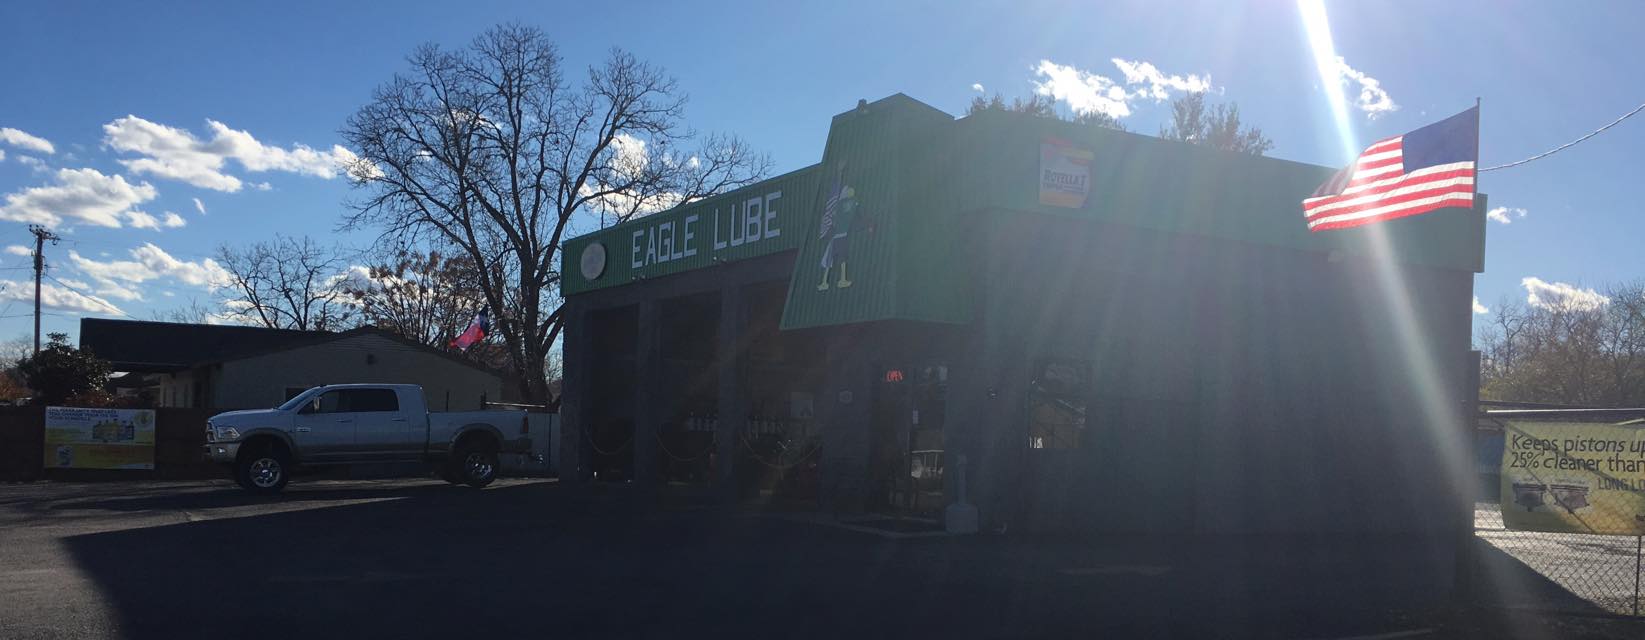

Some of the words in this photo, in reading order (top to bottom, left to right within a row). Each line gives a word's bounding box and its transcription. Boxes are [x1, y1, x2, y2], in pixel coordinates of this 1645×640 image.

[632, 214, 699, 269] EAGLE
[714, 191, 782, 250] LUBE
[1512, 434, 1558, 455] Keeps
[1564, 435, 1626, 456] pistons
[1511, 451, 1540, 469] 25%
[1543, 453, 1603, 471] cleaner
[1607, 453, 1645, 472] than
[1598, 477, 1629, 491] LONG
